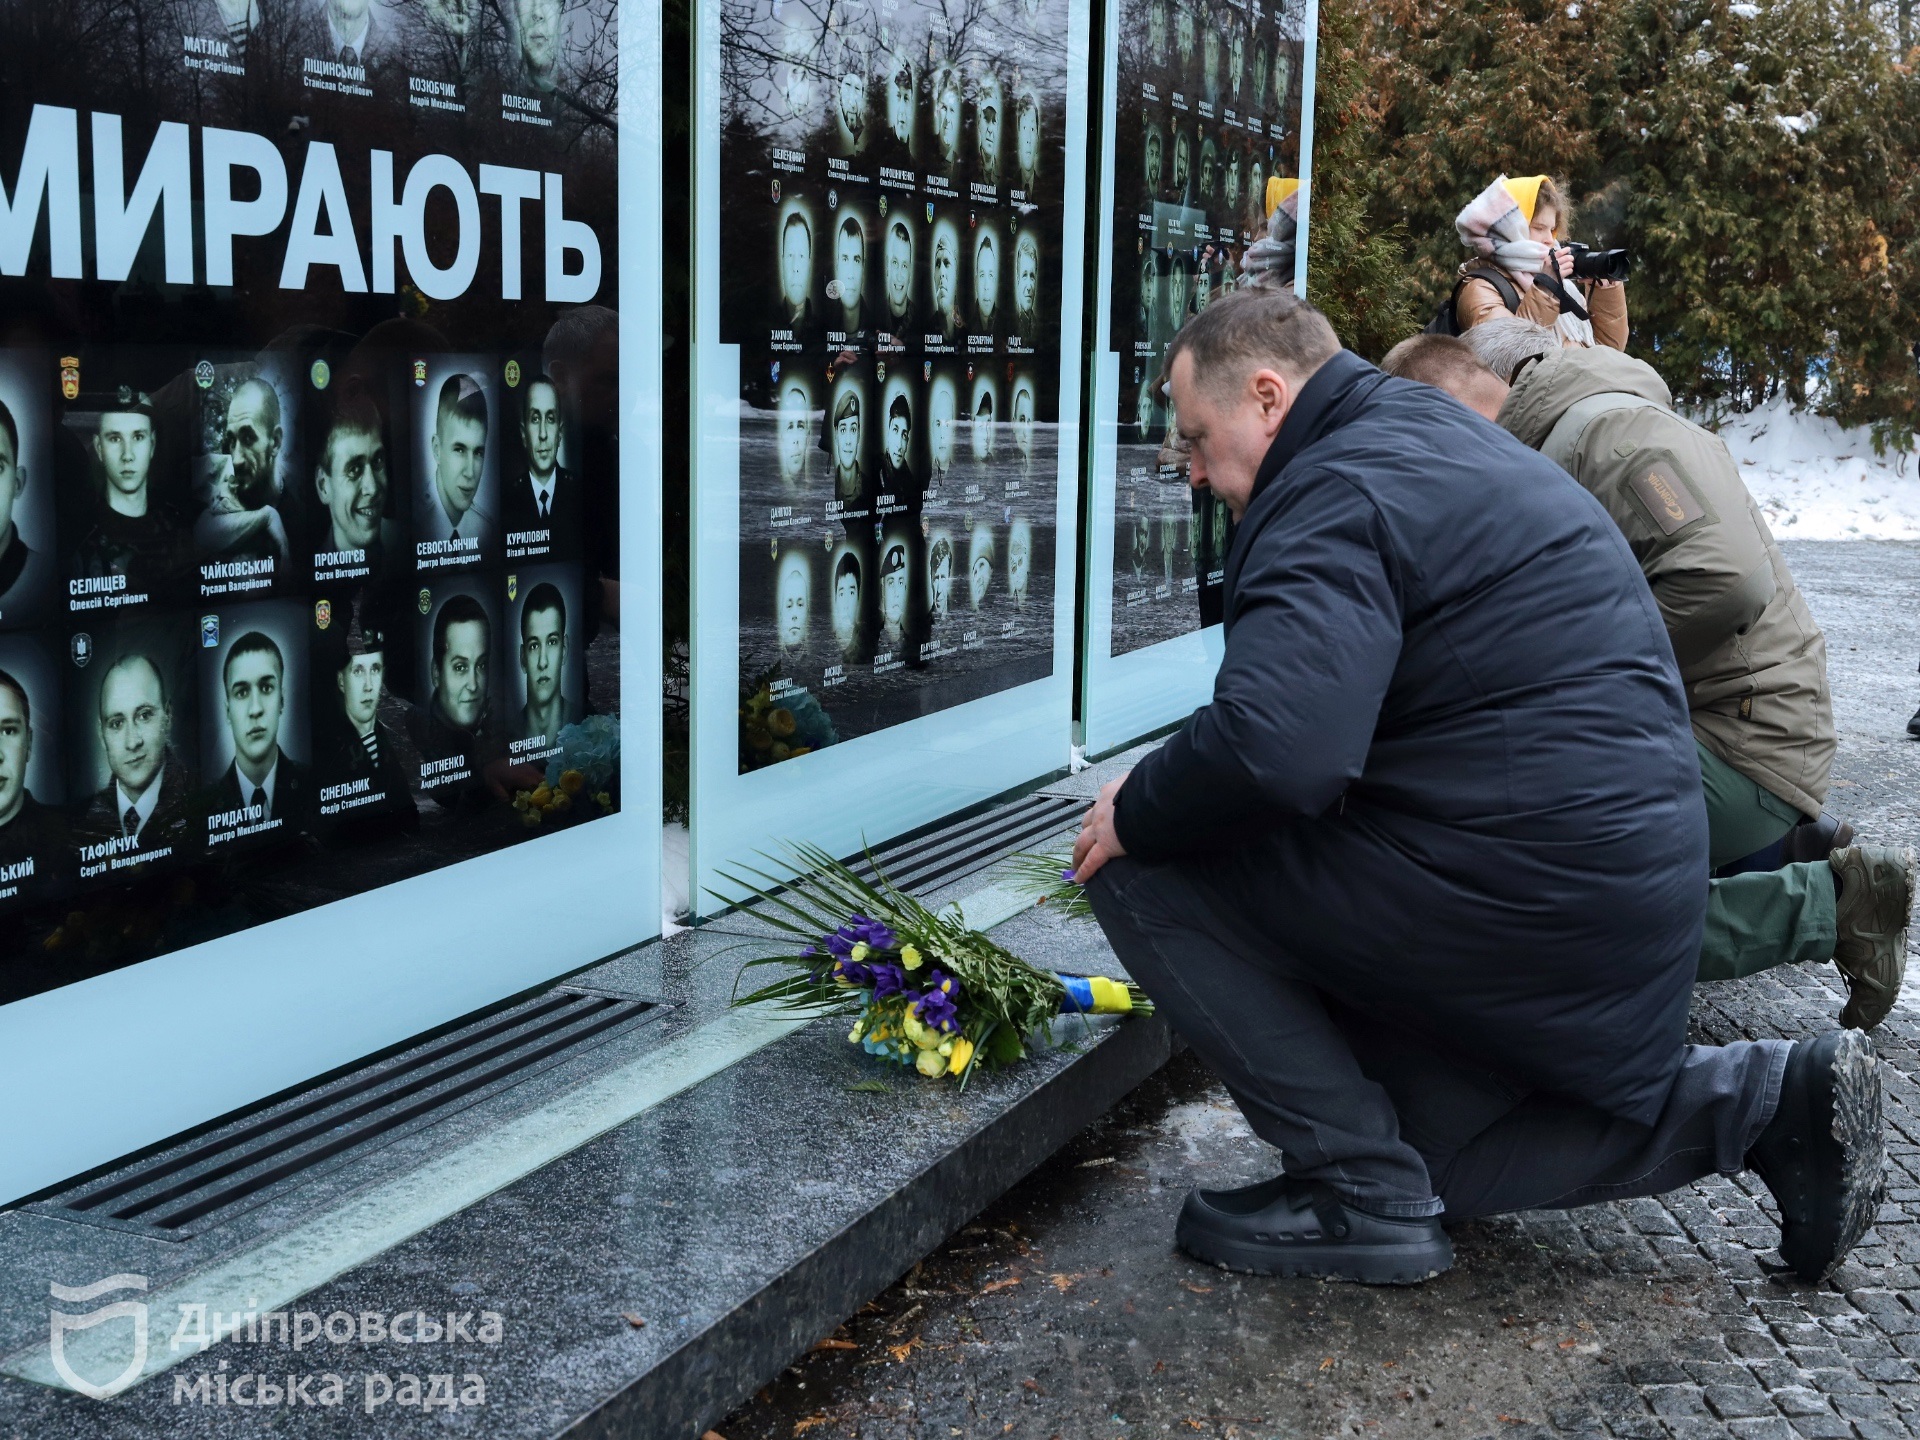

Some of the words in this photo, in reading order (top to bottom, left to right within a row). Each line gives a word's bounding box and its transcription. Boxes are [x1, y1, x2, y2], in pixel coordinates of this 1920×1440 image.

[184, 36, 229, 58] МАТЛАК
[184, 56, 202, 69] Олег
[204, 58, 245, 77] Сергійович
[303, 58, 366, 82] ЛІЩИНСЬКИЙ
[303, 76, 337, 91] Станіслав
[337, 81, 373, 97] Сергійович
[409, 77, 456, 98] КОЗЮБЧИК
[410, 94, 429, 107] Андрій
[430, 97, 466, 112] Михайлович
[502, 94, 542, 112] КОЛЕСНИК
[502, 110, 520, 122] Андрій
[521, 113, 552, 127] Михайлович
[0, 103, 602, 304] МИРАЮТЬ
[417, 537, 478, 556] СЕВОСТЬЯНЧИК
[507, 529, 550, 546] КУРИЛОВИЧ
[315, 549, 365, 568] ПРОКОП'ЄВ
[417, 559, 438, 570] Дмитро
[439, 553, 481, 567] Олександрович
[527, 546, 549, 556] Іванович
[200, 555, 274, 580] ЧАЙКОВСЬКИЙ
[315, 570, 334, 581] Євген
[335, 567, 370, 579] Вікторович
[69, 574, 127, 596] СЕЛИЩЕВ
[200, 583, 227, 596] Руслан
[228, 579, 272, 593] Валерійович
[70, 599, 102, 612] Олексій
[104, 593, 148, 608] Сергійович
[509, 734, 546, 754] ЧЕРНЕНКО
[420, 754, 465, 777] ЦВІТНЕНКО
[509, 755, 525, 766] Роман
[526, 746, 564, 764] Олександрович
[320, 778, 370, 802] СІНЕЛЬНИК
[421, 776, 440, 790] Андрій
[441, 770, 471, 786] Сергійович
[320, 802, 340, 815] Федір
[341, 791, 386, 811] Станіславович
[208, 804, 262, 830] ПРИДАТКО
[208, 831, 235, 847] Дмитро
[236, 818, 283, 838] Миколайович
[80, 835, 139, 863] ТАФІЙЧУК
[80, 861, 107, 878] Сергій
[111, 847, 172, 871] Володимирович
